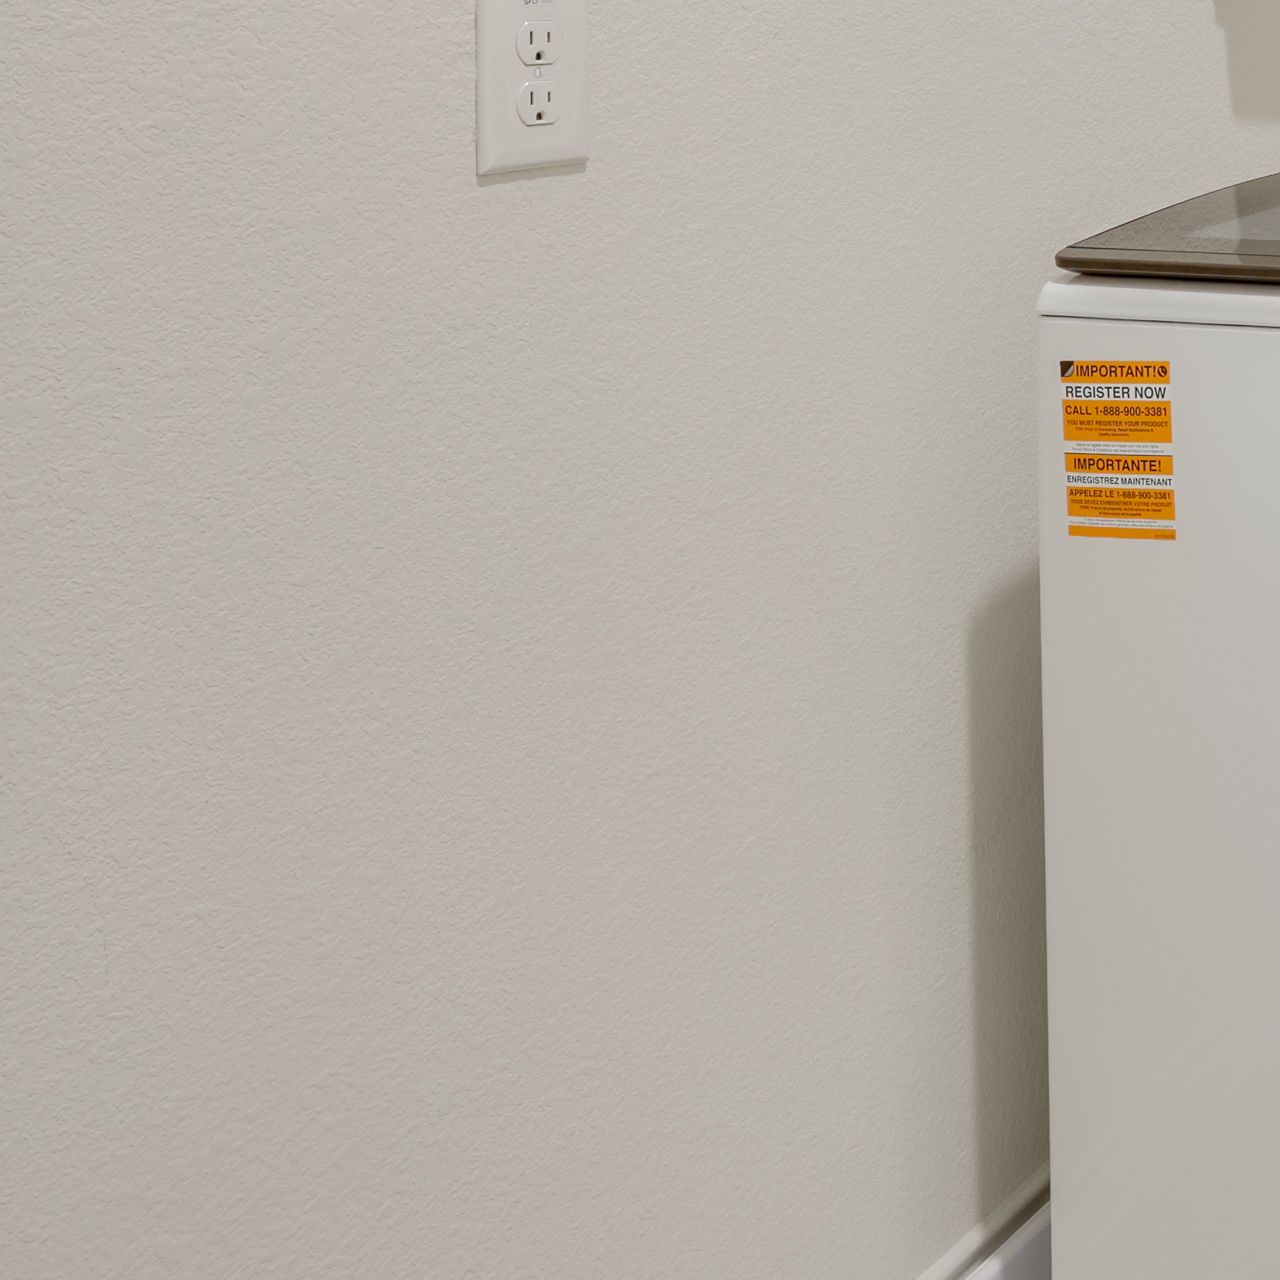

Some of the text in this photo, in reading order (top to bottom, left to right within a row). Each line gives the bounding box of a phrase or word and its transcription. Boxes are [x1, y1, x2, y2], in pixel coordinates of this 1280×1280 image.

[1076, 365, 1156, 377] IMPORTANT!
[1065, 386, 1166, 399] REGISTER NOW
[1065, 405, 1167, 416] CALL 1-888-900-3381
[1074, 458, 1161, 472] IMPORTANTE!
[1067, 475, 1172, 486] ENREGISTREZ MAINTENANT
[1069, 489, 1103, 497] APPELEZ
[1117, 491, 1171, 500] 1-888-900-3381
